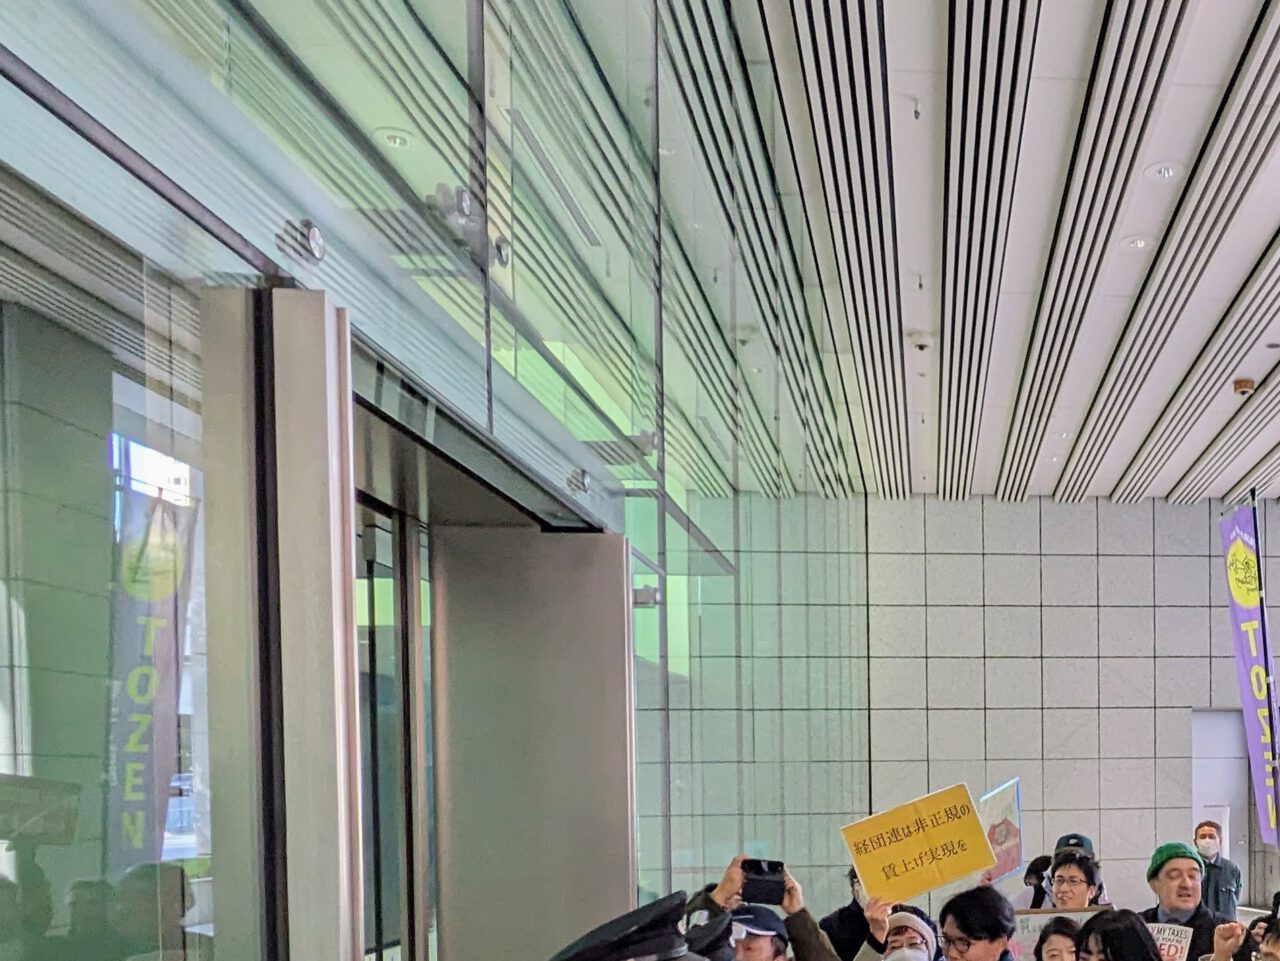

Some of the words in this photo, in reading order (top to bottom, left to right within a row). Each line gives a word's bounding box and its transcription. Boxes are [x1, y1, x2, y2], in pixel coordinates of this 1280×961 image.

[853, 804, 970, 857] 経団連は非正規の
[881, 839, 968, 881] 賃上げ実現を
[1168, 927, 1189, 939] TAXES
[1158, 943, 1185, 958] ED!
